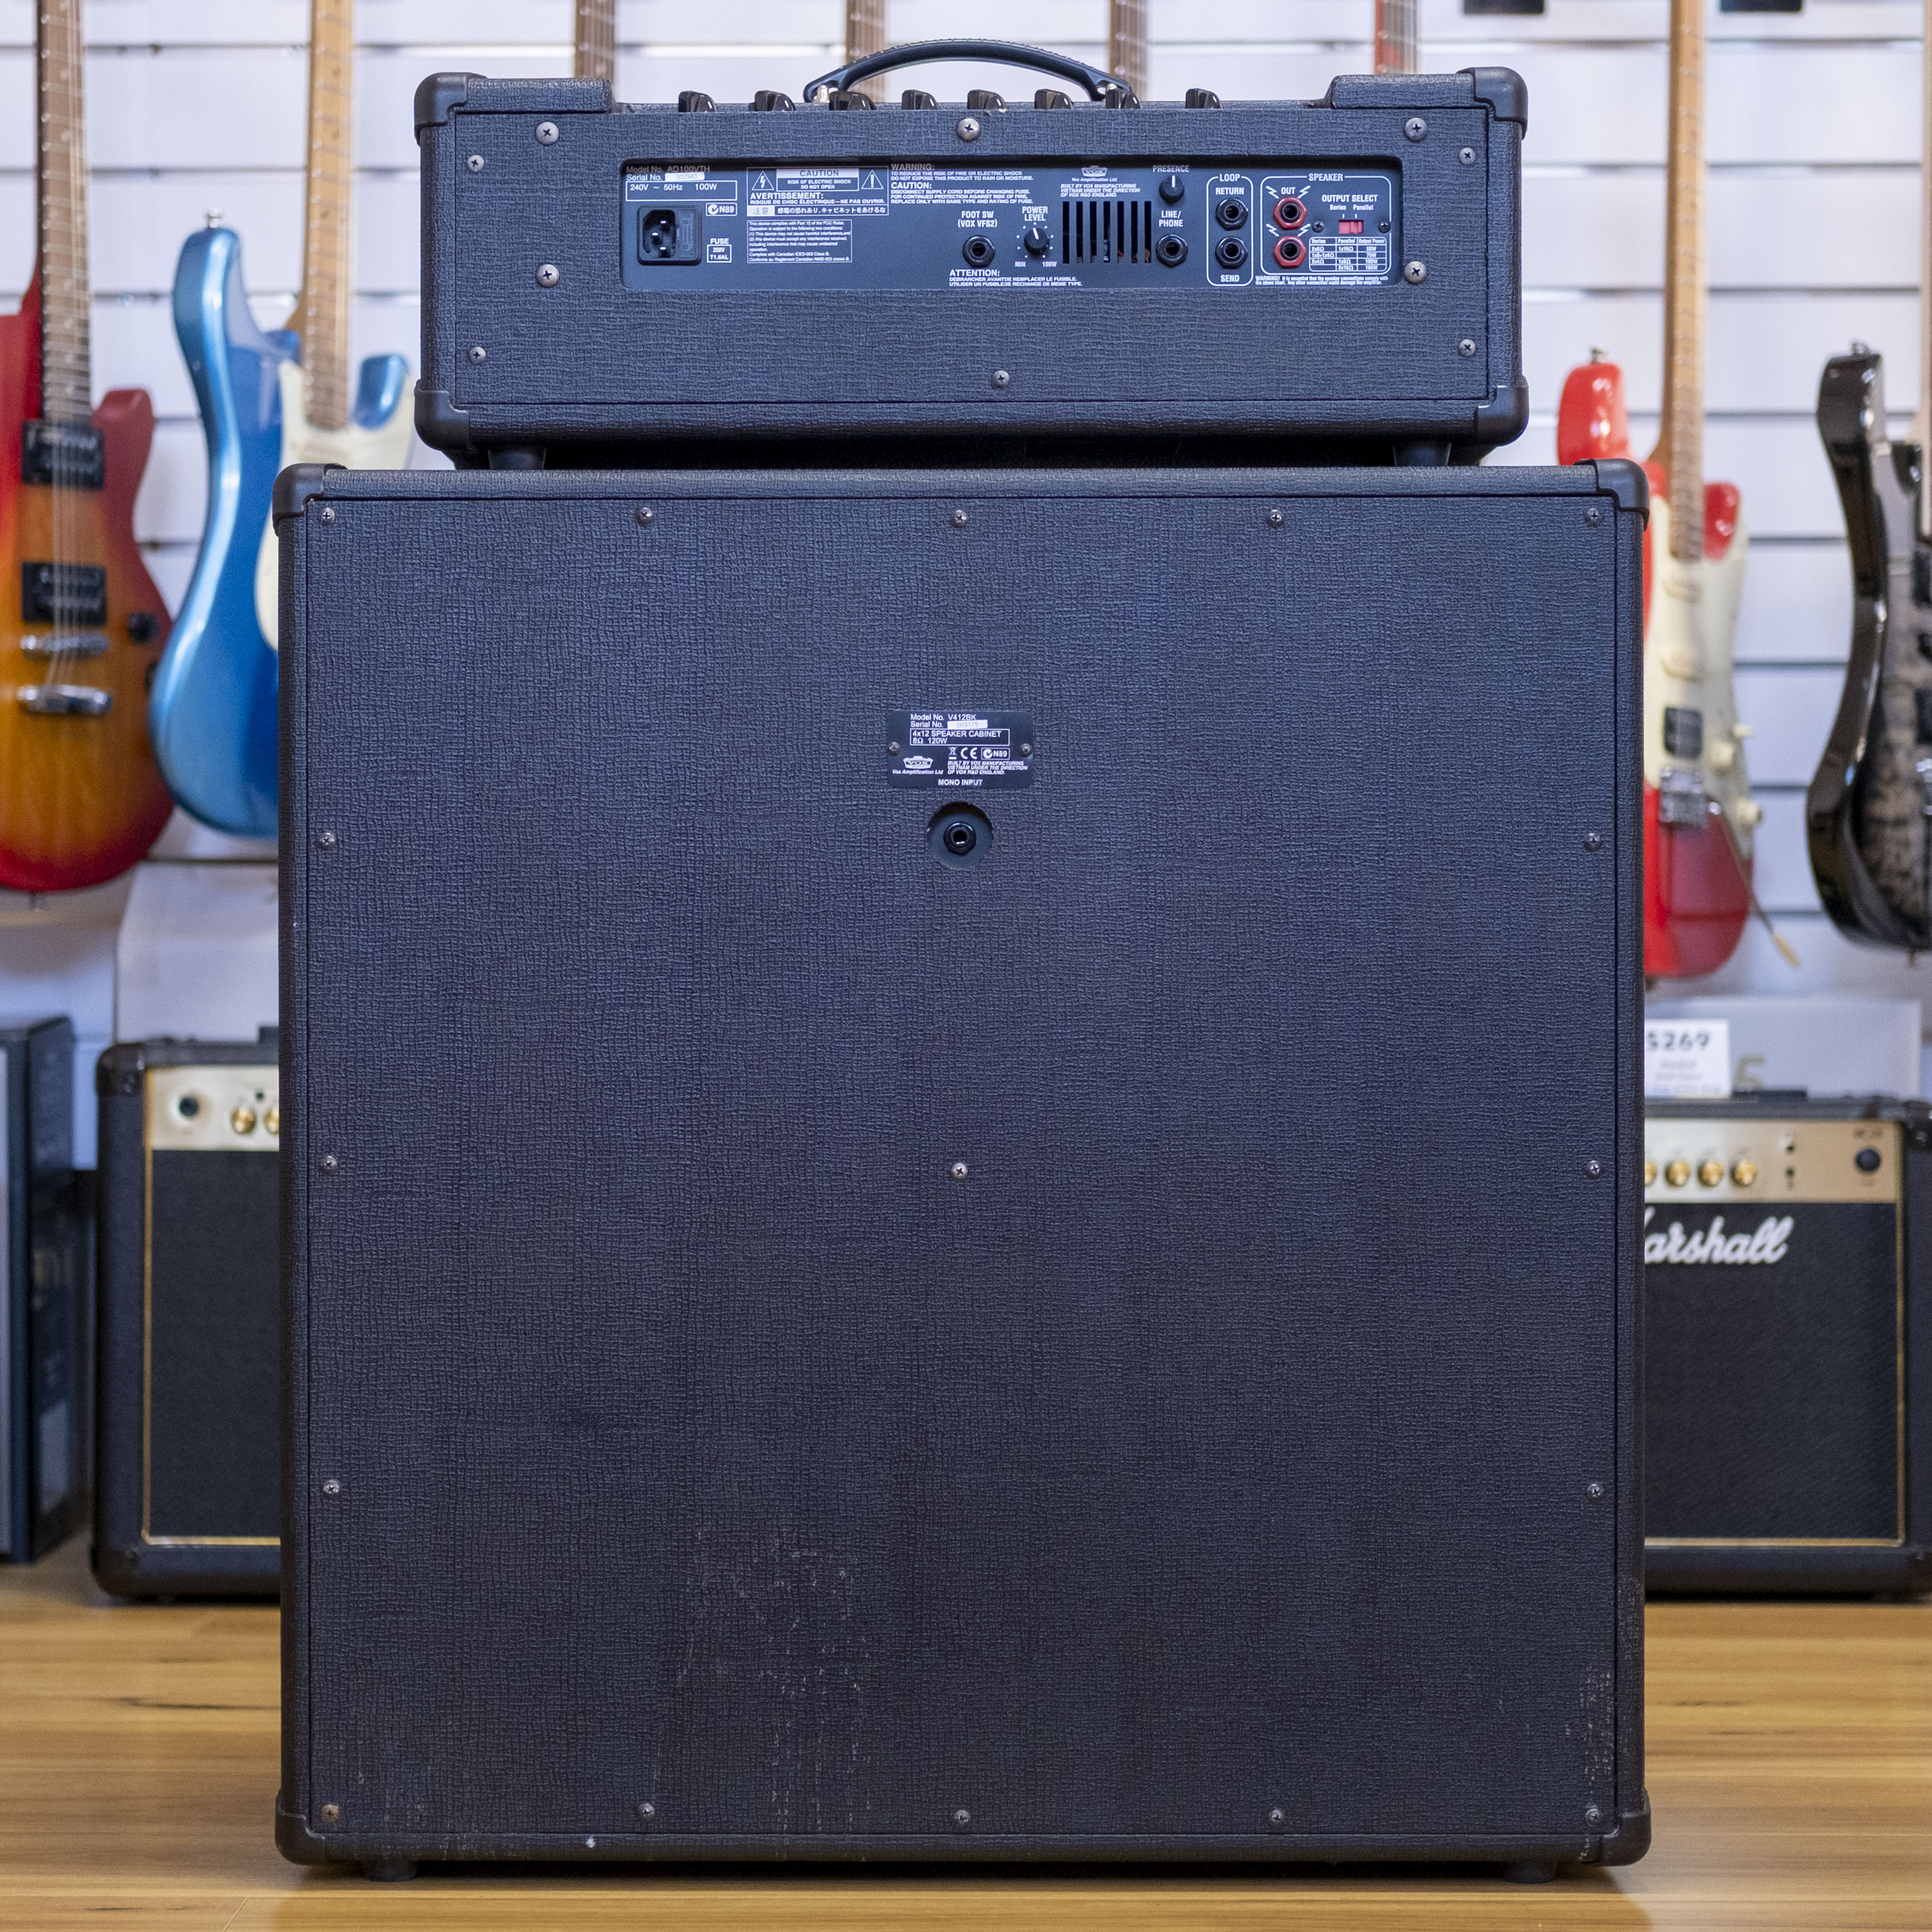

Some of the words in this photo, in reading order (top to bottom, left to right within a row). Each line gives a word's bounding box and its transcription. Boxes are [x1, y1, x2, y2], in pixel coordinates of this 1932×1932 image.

[1152, 165, 1190, 173] PRESENCE
[1219, 173, 1241, 182] LOOP
[1308, 173, 1344, 181] SPEAKER
[1281, 186, 1296, 195] OUT
[1322, 194, 1349, 203] OUTPUT
[1351, 194, 1378, 203] SELECT
[719, 205, 735, 214] N89
[962, 210, 979, 219] FOOT
[982, 210, 994, 219] SW
[958, 219, 975, 228] (VOX
[977, 219, 998, 228] VFS2)
[1220, 274, 1240, 283] SEND
[1645, 1207, 1794, 1265] arshall
